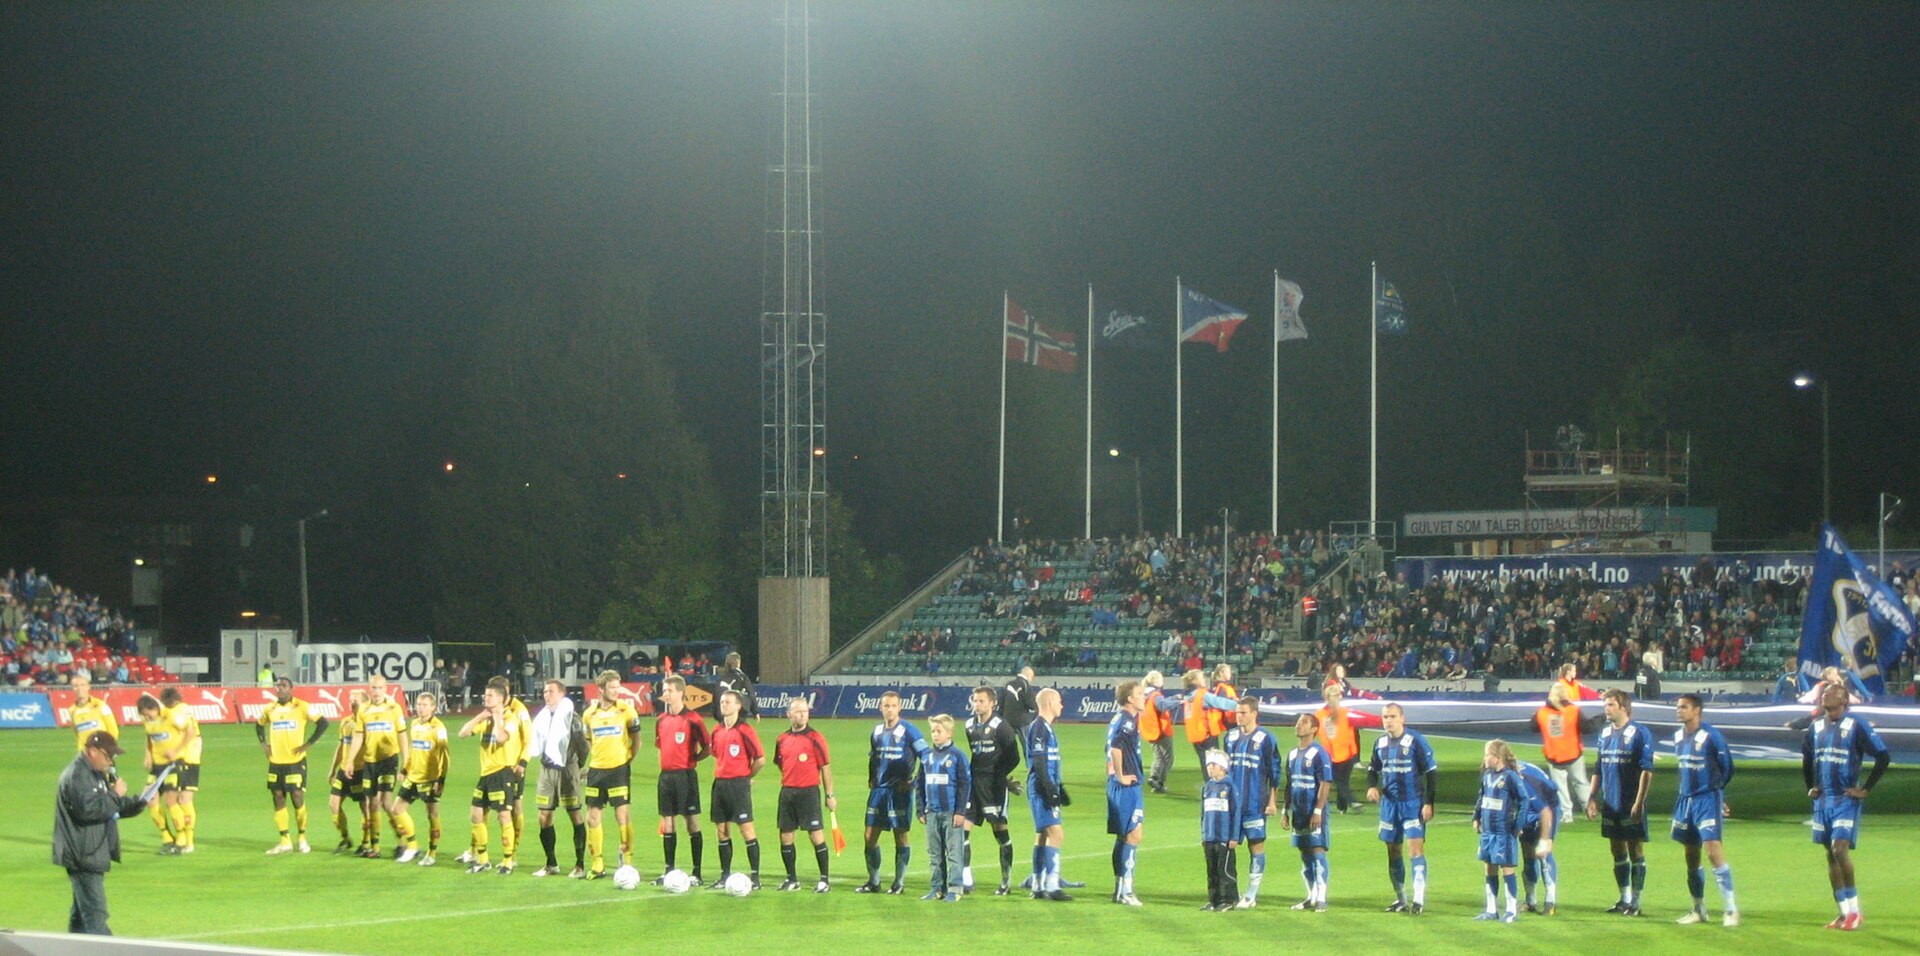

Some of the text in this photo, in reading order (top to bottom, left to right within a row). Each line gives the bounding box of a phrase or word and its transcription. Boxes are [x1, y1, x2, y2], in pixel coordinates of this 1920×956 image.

[1411, 520, 1453, 534] GULVET
[1456, 520, 1480, 533] SOM
[321, 651, 428, 681] PERGO
[917, 692, 928, 711] 1
[1, 708, 34, 721] NCC
